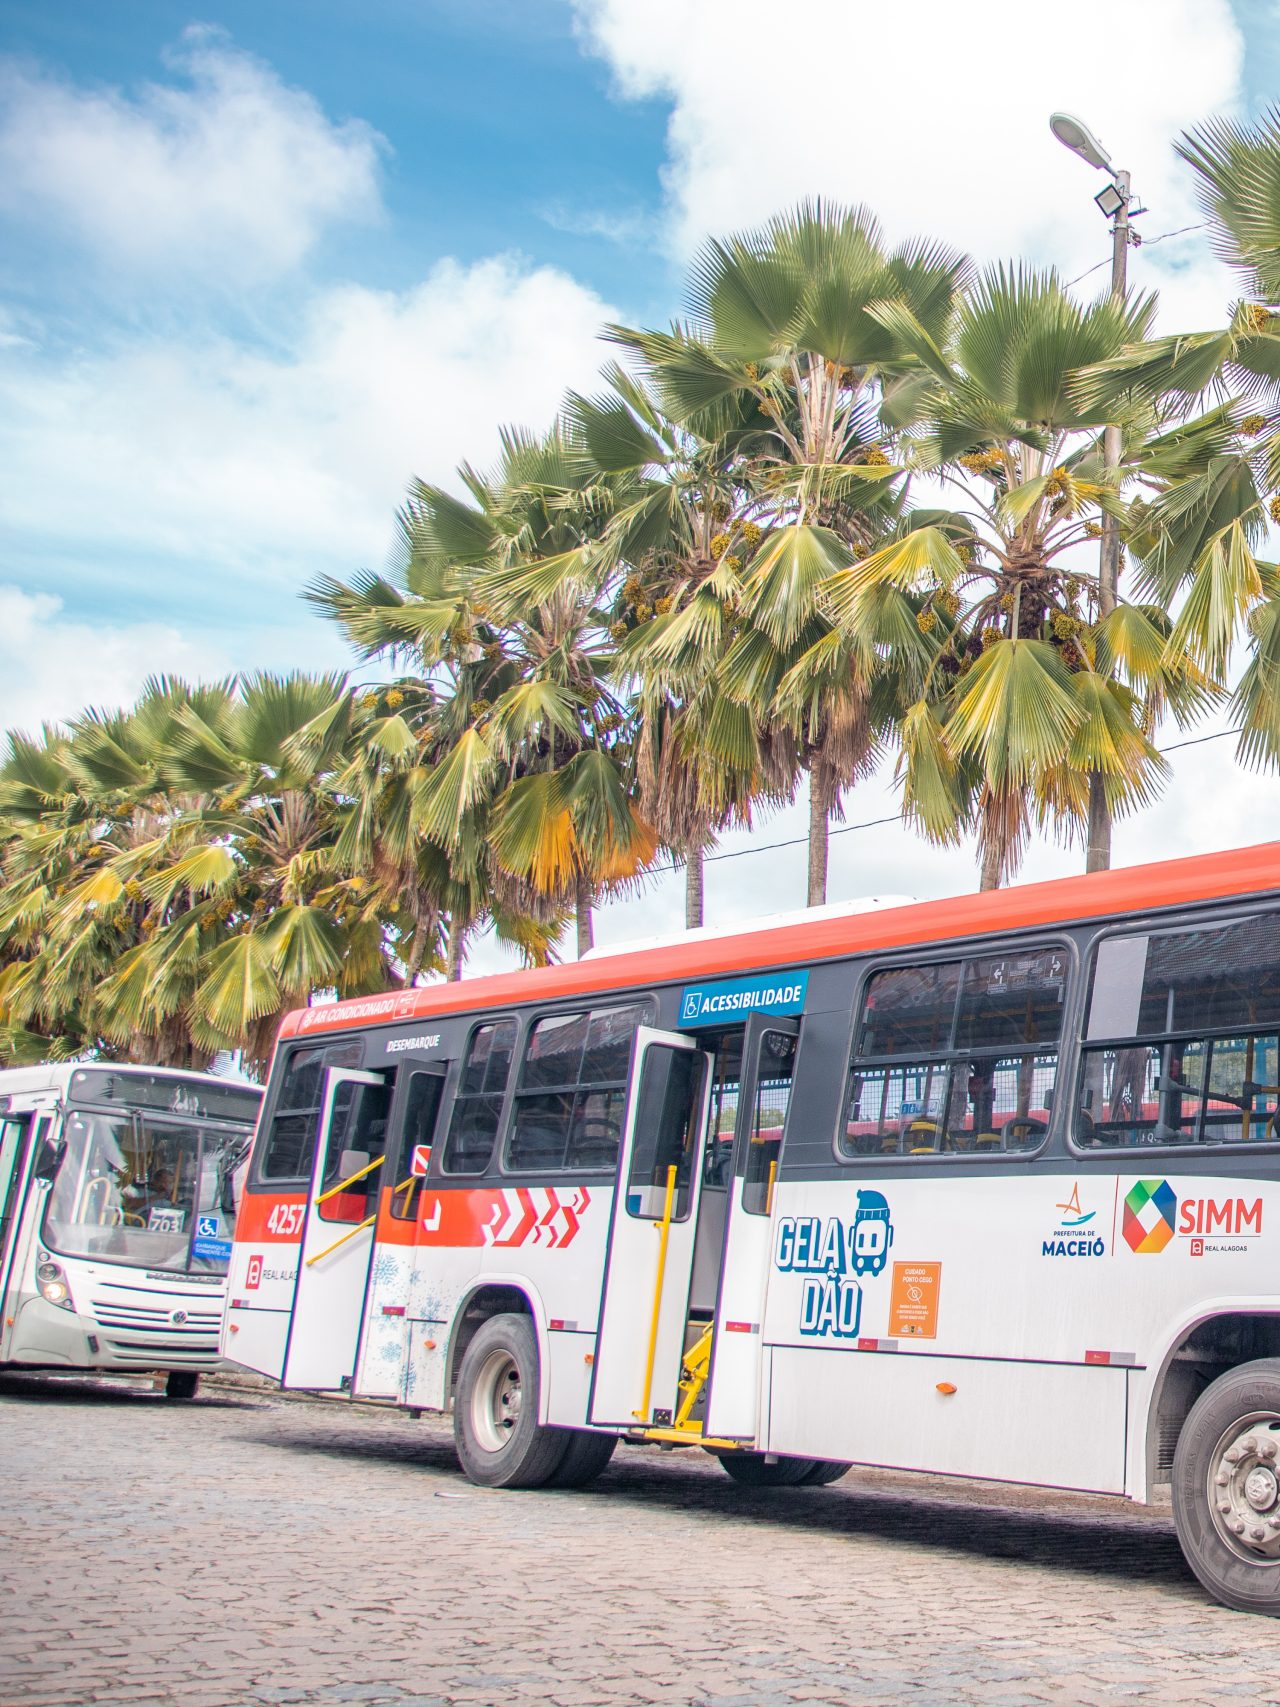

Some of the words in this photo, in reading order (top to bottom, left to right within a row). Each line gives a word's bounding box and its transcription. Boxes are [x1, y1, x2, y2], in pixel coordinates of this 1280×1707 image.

[313, 1009, 326, 1025] AR
[327, 998, 395, 1022] CONDICIONADO
[700, 985, 803, 1014] ACESSIBILIDADE
[386, 1034, 441, 1053] DESEMBARQUE
[150, 1219, 179, 1233] 703
[267, 1203, 307, 1235] 4257
[1178, 1198, 1263, 1234] SIMM
[775, 1216, 847, 1275] GELA
[1042, 1236, 1105, 1257] MACEIÓ
[262, 1269, 279, 1280] REAL
[799, 1269, 863, 1338] DÃO
